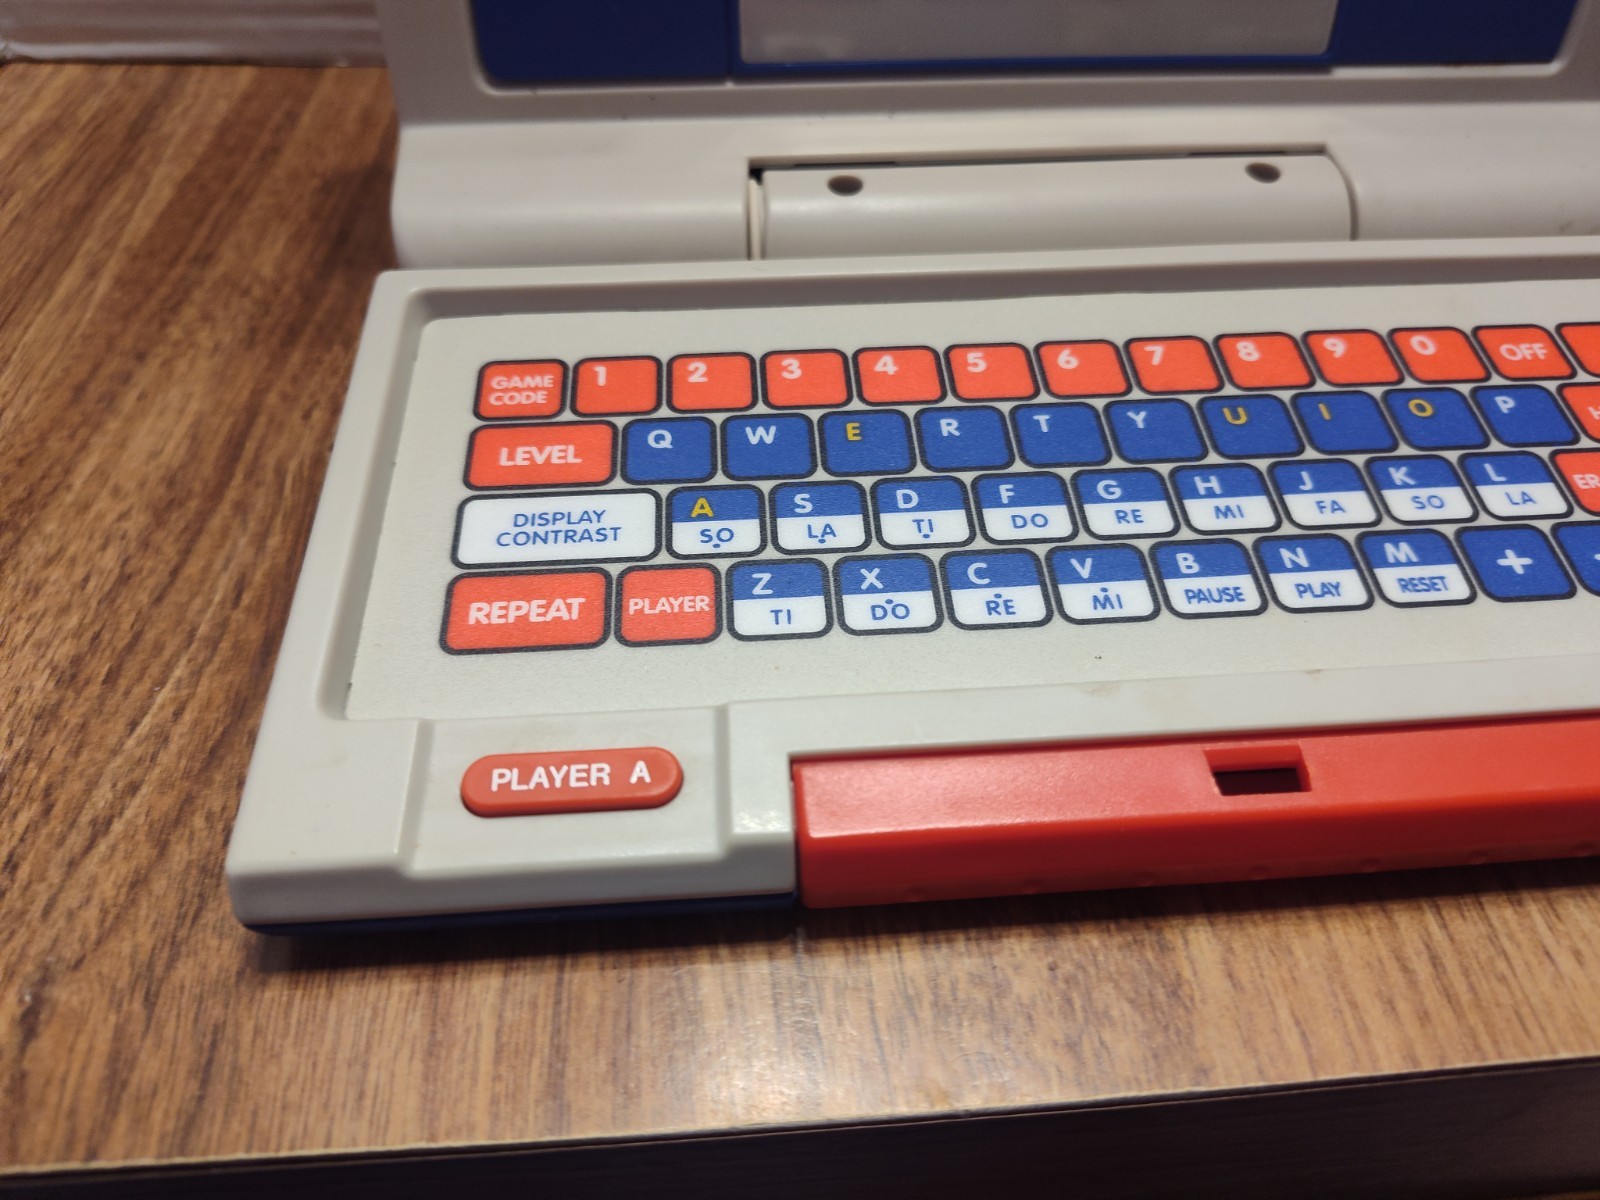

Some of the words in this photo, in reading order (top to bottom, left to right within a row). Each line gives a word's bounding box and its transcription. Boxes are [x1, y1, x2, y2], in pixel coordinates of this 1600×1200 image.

[1236, 341, 1260, 361] 8
[1323, 338, 1345, 357] 9
[1410, 335, 1436, 355] 0
[1500, 343, 1547, 360] OFF
[966, 352, 987, 372] 5
[1057, 349, 1079, 369] 6
[1144, 345, 1164, 365] 7
[687, 363, 707, 382] 2
[781, 359, 801, 379] 3
[874, 356, 898, 375] 4
[491, 375, 554, 389] GAME
[594, 366, 606, 386] 1
[488, 391, 548, 406] CODE
[1408, 399, 1434, 417] O
[1495, 396, 1515, 413] P
[1127, 411, 1147, 428] Y
[1223, 407, 1247, 424] U
[1318, 403, 1332, 420] I
[845, 422, 862, 441] E
[940, 418, 960, 437] R
[1033, 414, 1050, 432] T
[647, 430, 673, 449] Q
[745, 425, 776, 444] W
[500, 445, 582, 466] LEVEL
[1299, 471, 1314, 490] J
[1388, 466, 1416, 485] K
[1484, 463, 1507, 482] L
[999, 484, 1015, 503] F
[1096, 480, 1122, 500] G
[1194, 475, 1222, 495] H
[690, 497, 714, 517] A
[793, 494, 813, 513] S
[896, 490, 919, 508] D
[1315, 500, 1346, 514] FA
[1411, 495, 1445, 509] SO
[1505, 492, 1536, 506] LA
[513, 509, 606, 528] DISPLAY
[1011, 513, 1049, 529] DO
[1114, 509, 1144, 524] RE
[1214, 505, 1244, 519] MI
[700, 527, 734, 543] SO
[807, 523, 837, 539] LA
[912, 519, 934, 534] TI
[496, 527, 621, 546] CONTRAST
[1279, 547, 1309, 568] N
[1384, 542, 1419, 563] M
[1070, 558, 1093, 579] V
[1175, 553, 1200, 574] B
[860, 568, 883, 590] X
[967, 563, 990, 585] C
[752, 573, 773, 595] Z
[1294, 582, 1341, 599] PLAY
[1397, 576, 1448, 593] RESET
[1092, 594, 1123, 611] MI
[1184, 586, 1246, 605] PAUSE
[468, 597, 586, 625] REPEAT
[628, 596, 710, 616] PLAYER
[870, 603, 910, 621] DO
[986, 599, 1016, 616] RE
[770, 609, 792, 625] TI
[491, 763, 611, 792] PLAYER
[630, 760, 651, 784] A
